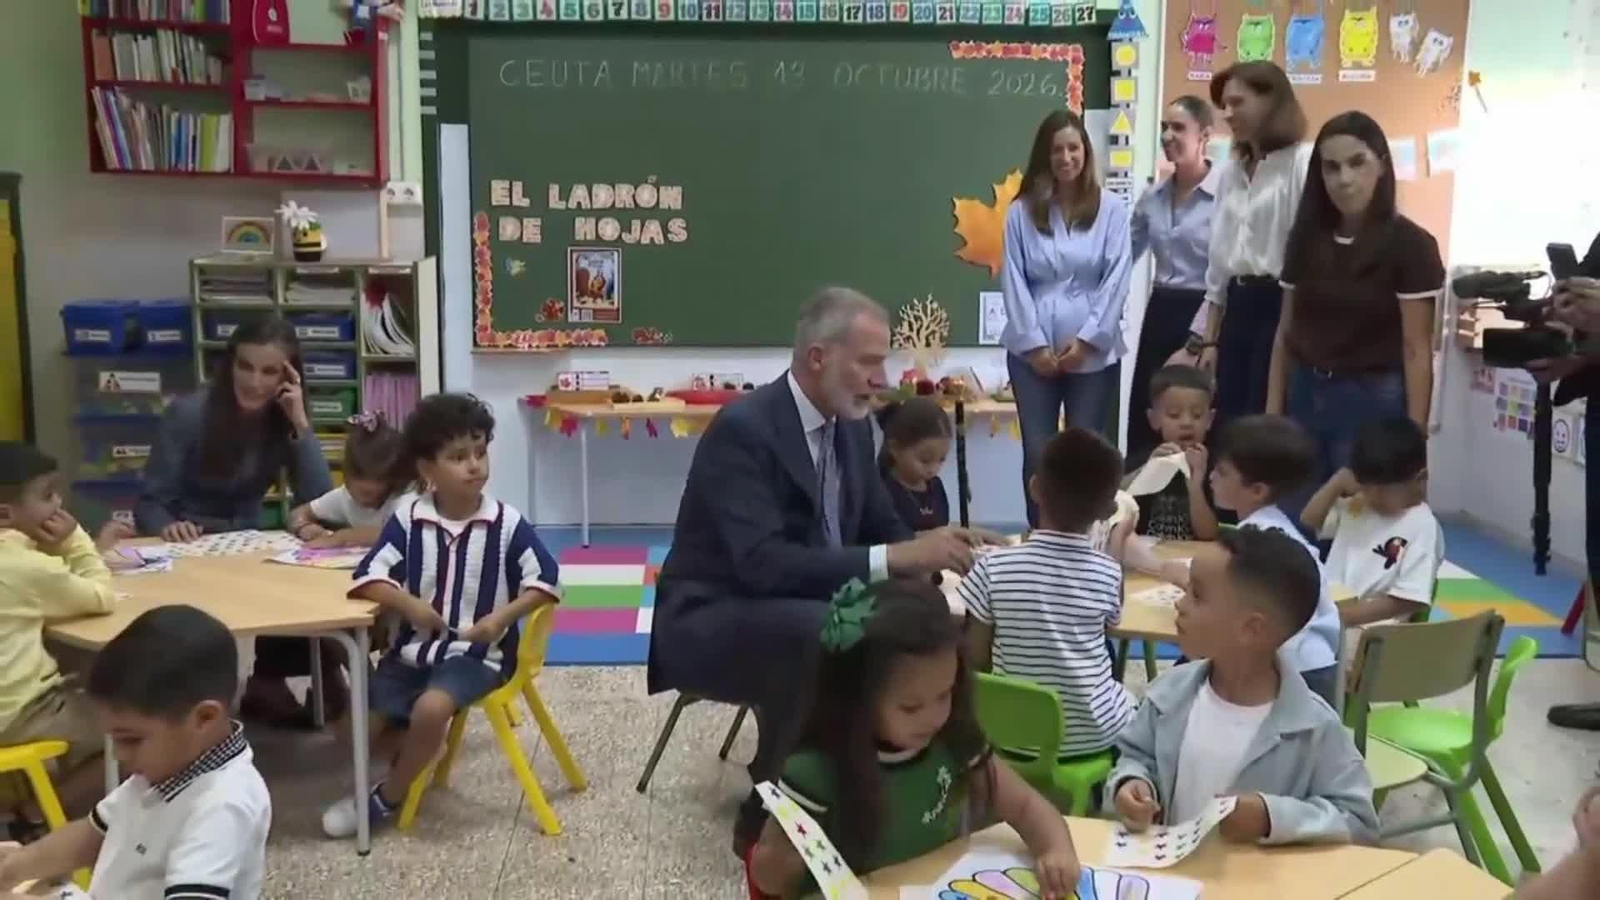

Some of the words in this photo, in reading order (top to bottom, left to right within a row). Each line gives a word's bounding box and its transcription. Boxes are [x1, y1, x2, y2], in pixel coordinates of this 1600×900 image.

[469, 0, 479, 18] 1
[492, 2, 506, 18] 2
[516, 2, 529, 18] 3
[540, 0, 553, 18] 4
[563, 2, 577, 18] 5
[587, 2, 600, 18] 6
[612, 2, 624, 17] 7
[635, 1, 648, 17] 8
[657, 2, 671, 18] 9
[680, 3, 696, 18] 10
[704, 3, 721, 19] 11
[727, 3, 745, 19] 12
[751, 3, 768, 19] 13
[775, 4, 792, 19] 14
[798, 4, 814, 20] 15
[821, 4, 837, 20] 16
[846, 5, 861, 20] 17
[868, 5, 885, 20] 18
[892, 5, 907, 20] 19
[914, 5, 932, 20] 20
[938, 6, 954, 21] 21
[1006, 5, 1023, 21] 24
[1032, 6, 1049, 21] 25
[1053, 8, 1071, 22] 26
[1076, 7, 1094, 21] 27
[500, 59, 613, 88] CEUTA
[632, 60, 747, 88] MARTES
[834, 61, 965, 93] OCTUBRE
[491, 179, 530, 207] EL
[548, 175, 682, 210] LADRÓN
[499, 216, 541, 243] DE
[574, 217, 688, 245] HOJAS
